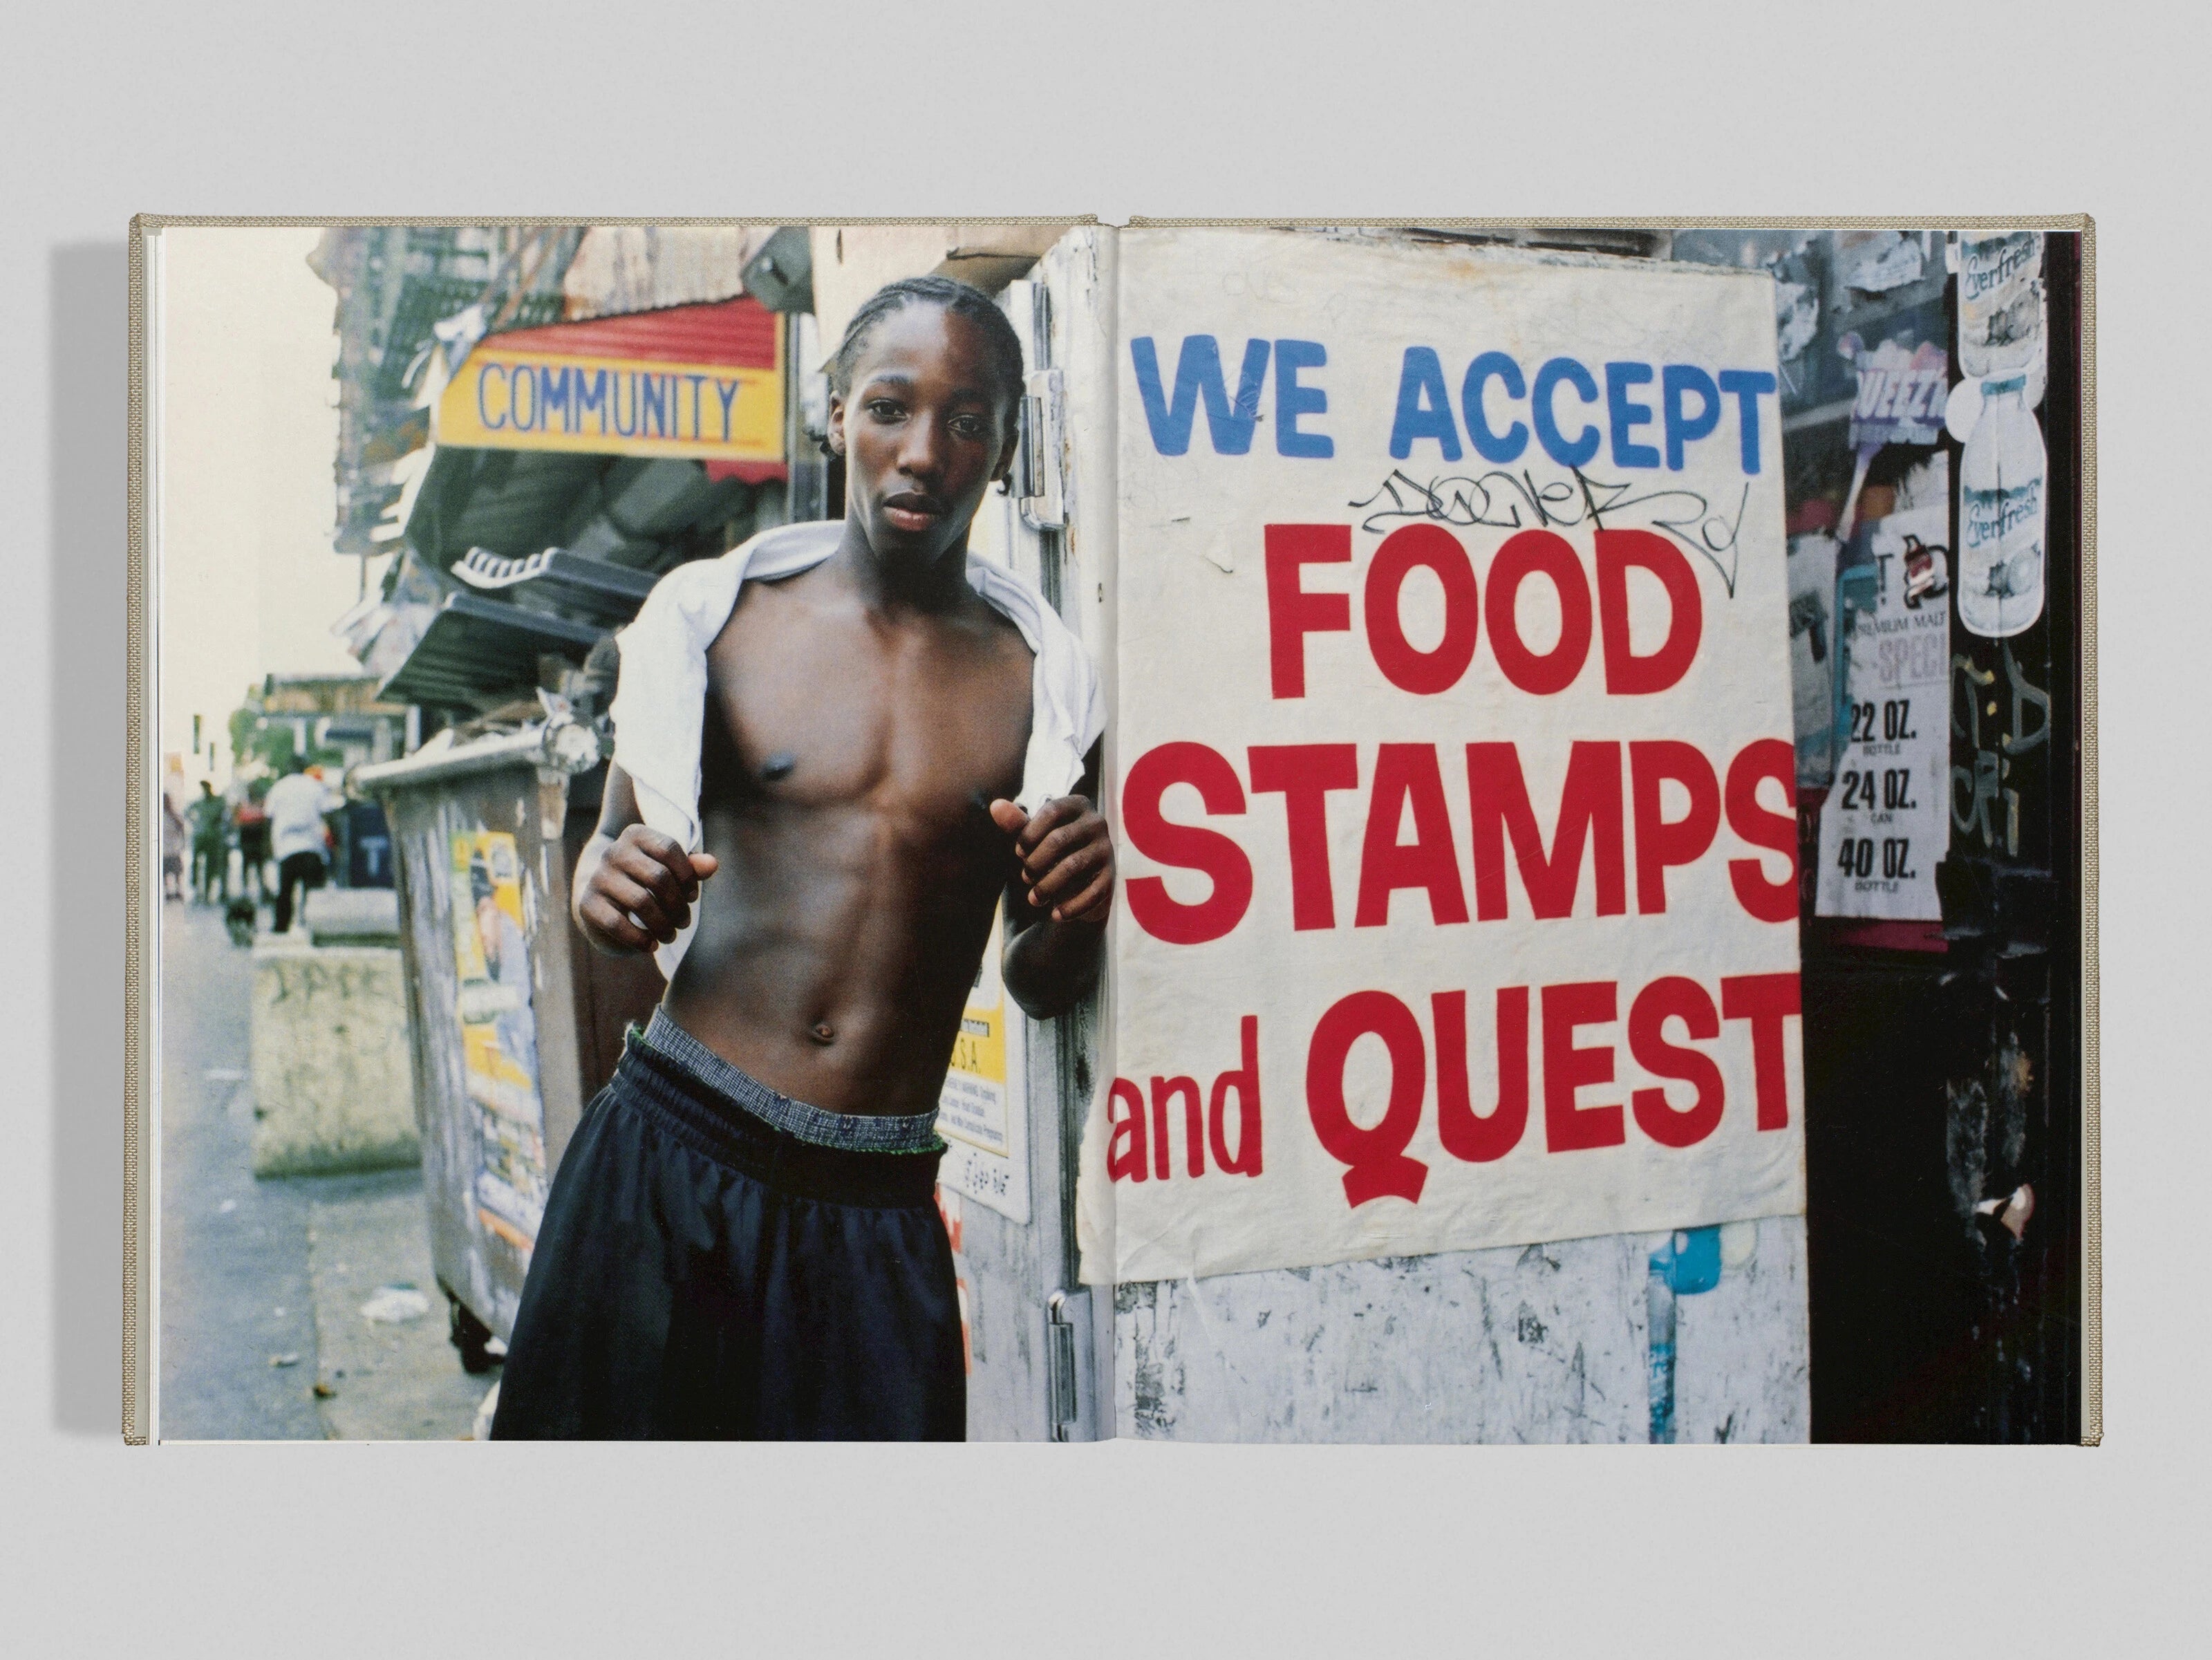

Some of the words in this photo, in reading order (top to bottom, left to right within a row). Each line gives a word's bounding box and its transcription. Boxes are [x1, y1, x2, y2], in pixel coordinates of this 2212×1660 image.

[1965, 239, 2036, 300] Everfresh
[478, 362, 738, 442] COMMUNITY
[1130, 334, 1334, 458] WE
[1389, 346, 1777, 474] ACCEPT
[1967, 486, 2037, 548] Everfresh
[1264, 523, 1703, 699] FOOD
[1850, 702, 1876, 743] 22
[1884, 699, 1917, 741] OZ.
[1863, 743, 1901, 756] BOTTLE
[1841, 770, 1875, 810] 24
[1884, 769, 1917, 810] OZ.
[1122, 738, 1799, 944] STAMPS
[1837, 838, 1874, 877] 40
[1882, 837, 1917, 879] OZ.
[1854, 879, 1900, 894] BOTTLE
[1107, 1015, 1264, 1184] and
[1306, 972, 1802, 1210] QUEST
